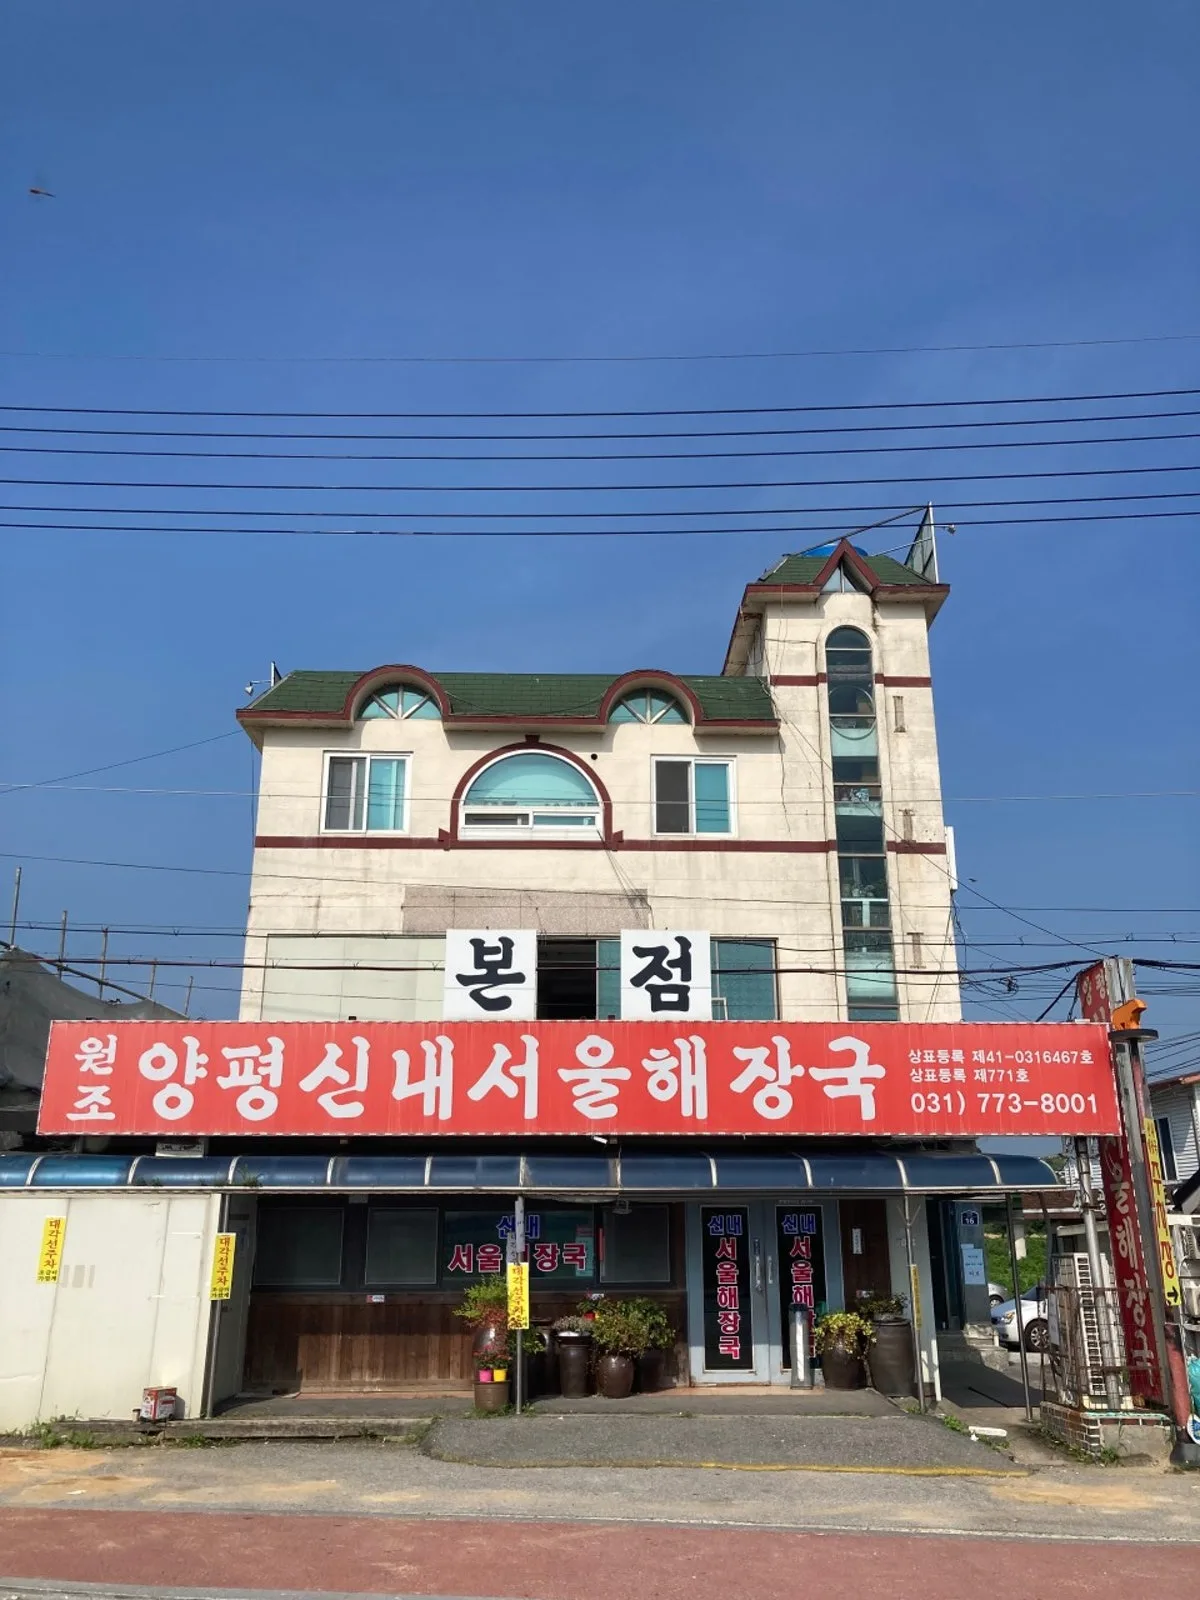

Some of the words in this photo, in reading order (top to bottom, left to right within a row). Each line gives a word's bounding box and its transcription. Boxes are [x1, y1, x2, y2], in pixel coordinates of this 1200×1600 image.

[456, 937, 526, 1011] 본
[630, 936, 692, 1013] 점
[908, 1049, 965, 1064] 상표등록
[972, 1049, 1094, 1064] 제41-0316467호
[66, 1034, 117, 1122] 원조
[138, 1034, 886, 1122] 양평신내서울해장국
[910, 1068, 967, 1083] 상표등록
[974, 1068, 1030, 1083] 제771호
[911, 1091, 966, 1115] 031)
[977, 1093, 1097, 1114] 773-8001
[707, 1214, 743, 1235] 신내
[781, 1213, 816, 1234] 신내
[448, 1243, 587, 1272] 서울장국
[715, 1236, 741, 1360] 서울해장국
[790, 1235, 816, 1358] 서울해
